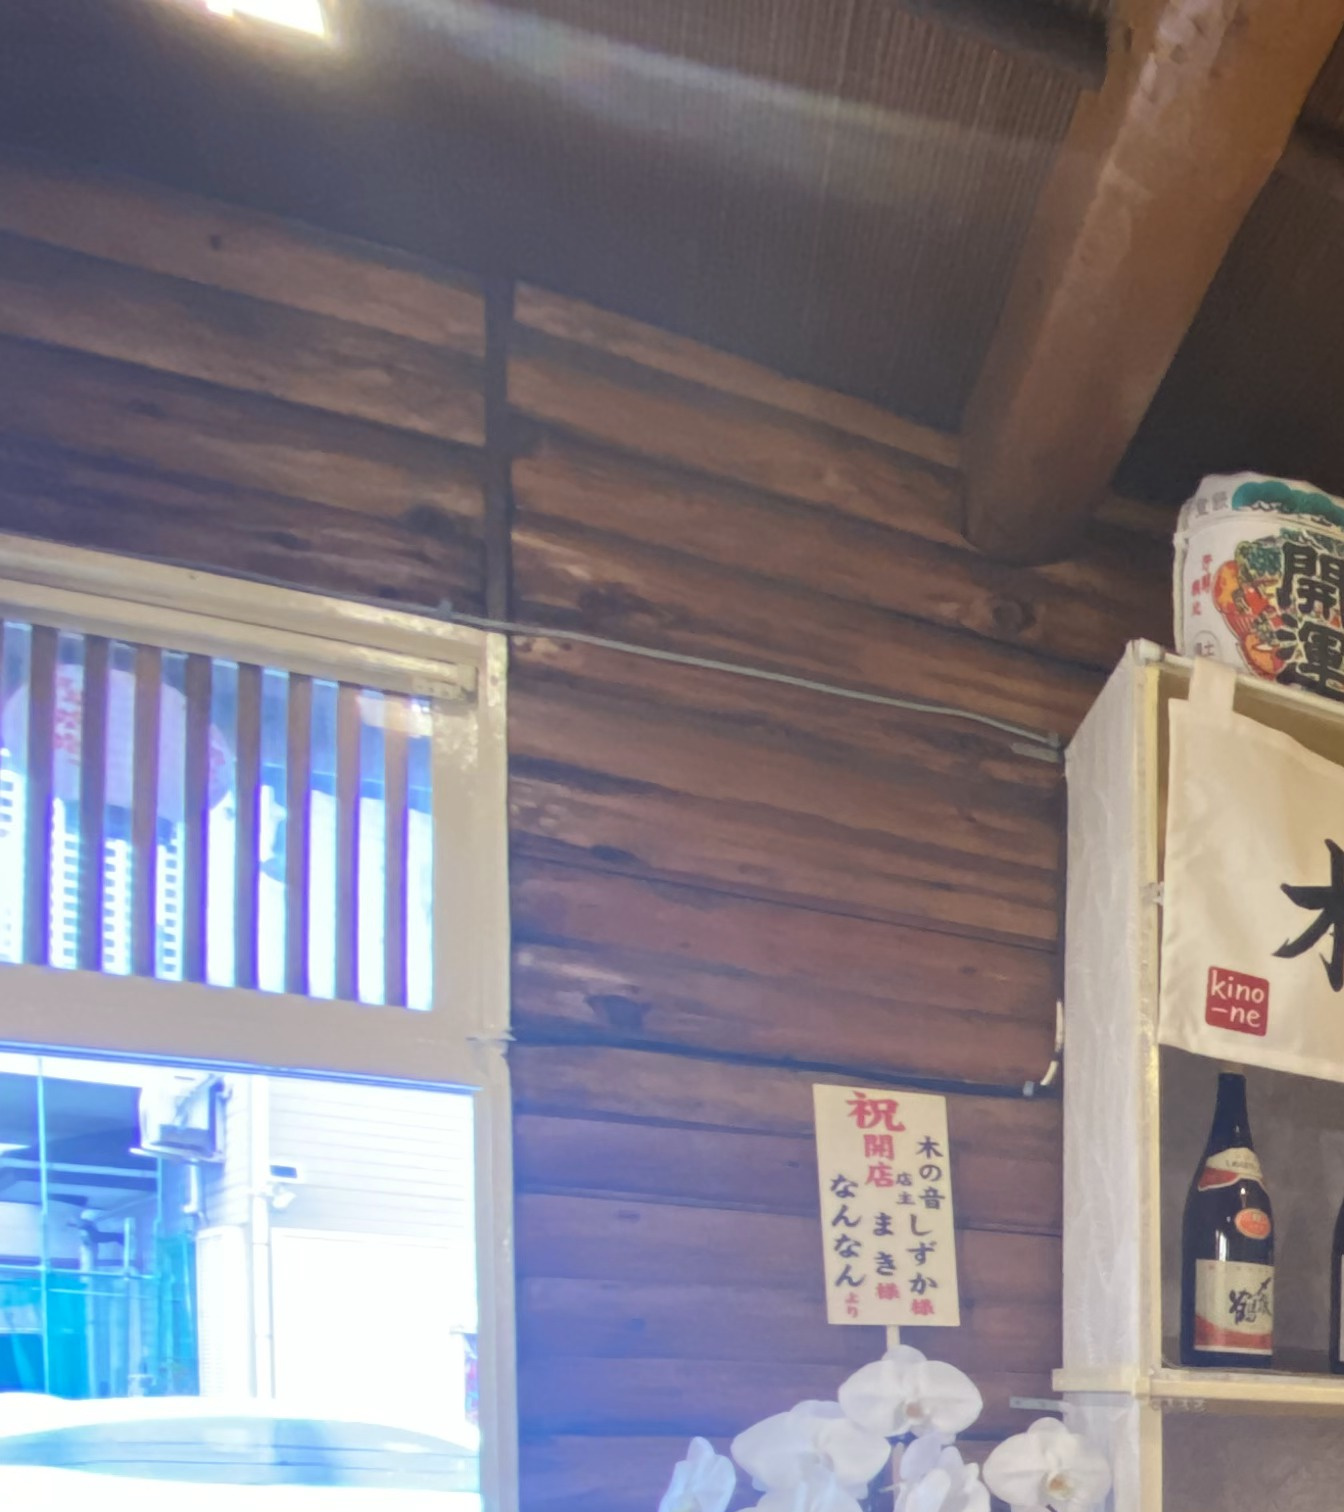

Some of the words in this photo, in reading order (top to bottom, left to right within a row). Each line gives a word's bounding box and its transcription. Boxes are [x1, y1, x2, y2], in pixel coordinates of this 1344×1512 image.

[1210, 969, 1265, 1004] kino
[916, 1136, 946, 1210] 木の音
